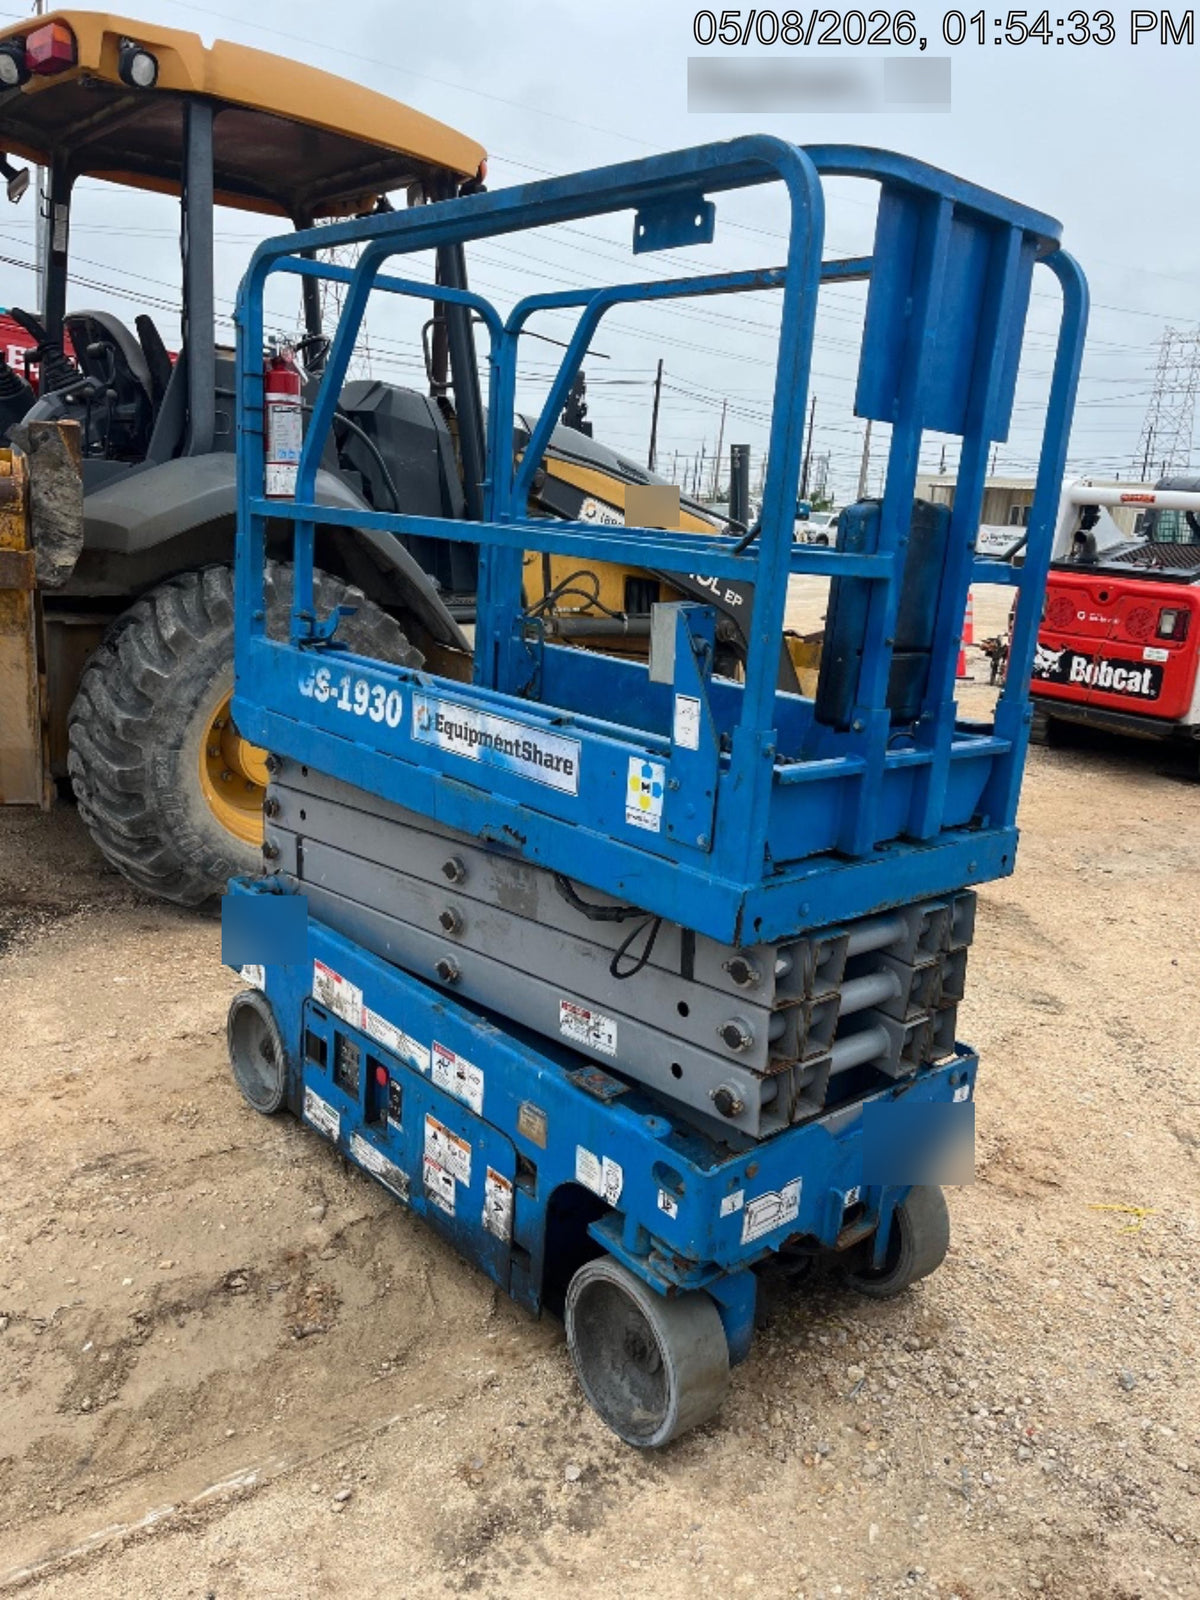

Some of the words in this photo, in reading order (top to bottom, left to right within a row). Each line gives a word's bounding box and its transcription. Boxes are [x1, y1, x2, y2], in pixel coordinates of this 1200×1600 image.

[724, 587, 743, 606] EP
[298, 667, 402, 728] GS-1930
[1069, 655, 1152, 694] Bobcat
[435, 713, 574, 776] EquipmentShare
